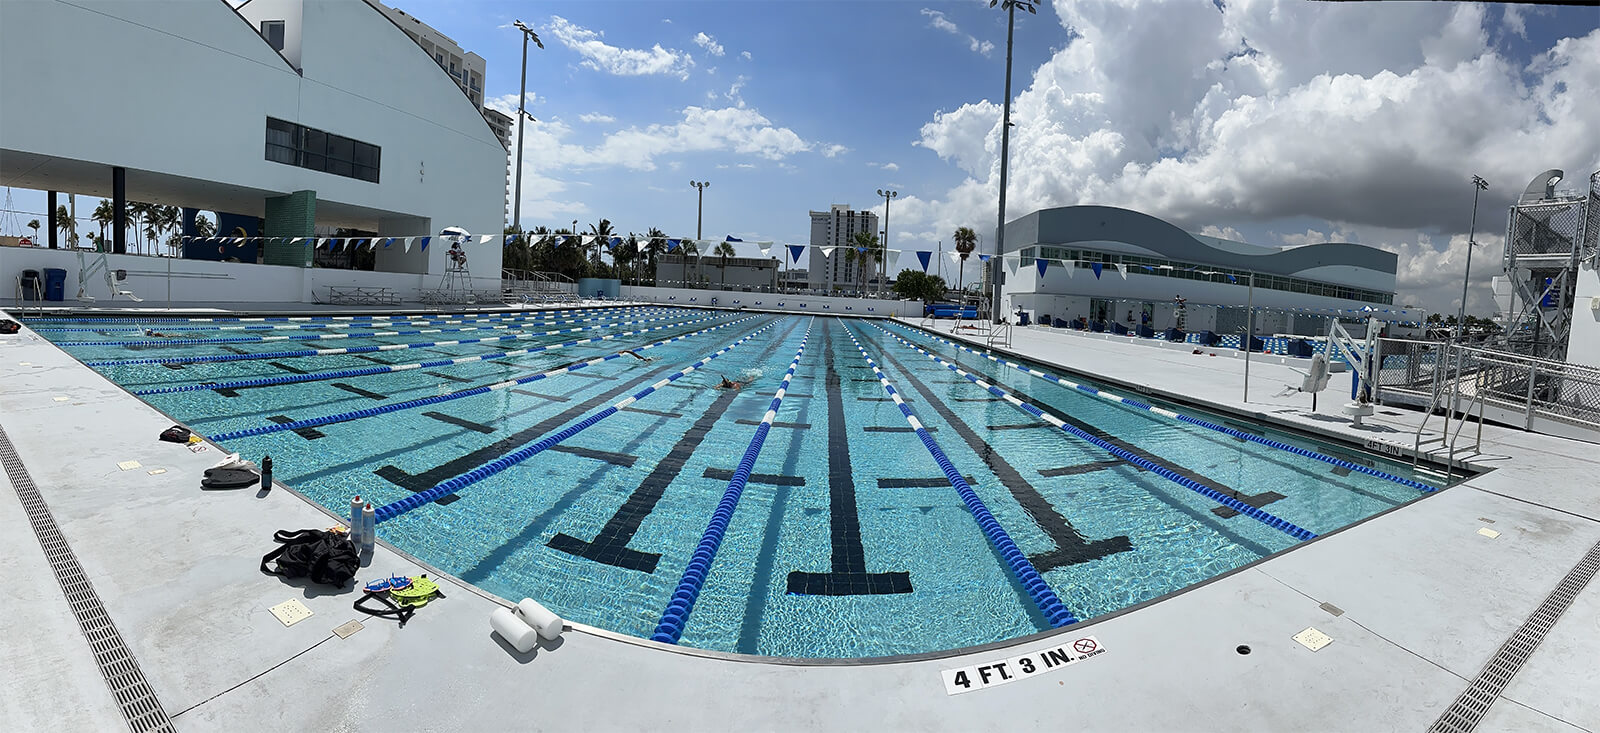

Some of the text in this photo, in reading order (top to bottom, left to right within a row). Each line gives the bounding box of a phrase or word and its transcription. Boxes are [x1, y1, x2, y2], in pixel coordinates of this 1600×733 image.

[1367, 440, 1400, 455] 4FT 3IN
[954, 648, 1075, 688] 4 FT. 3 IN.
